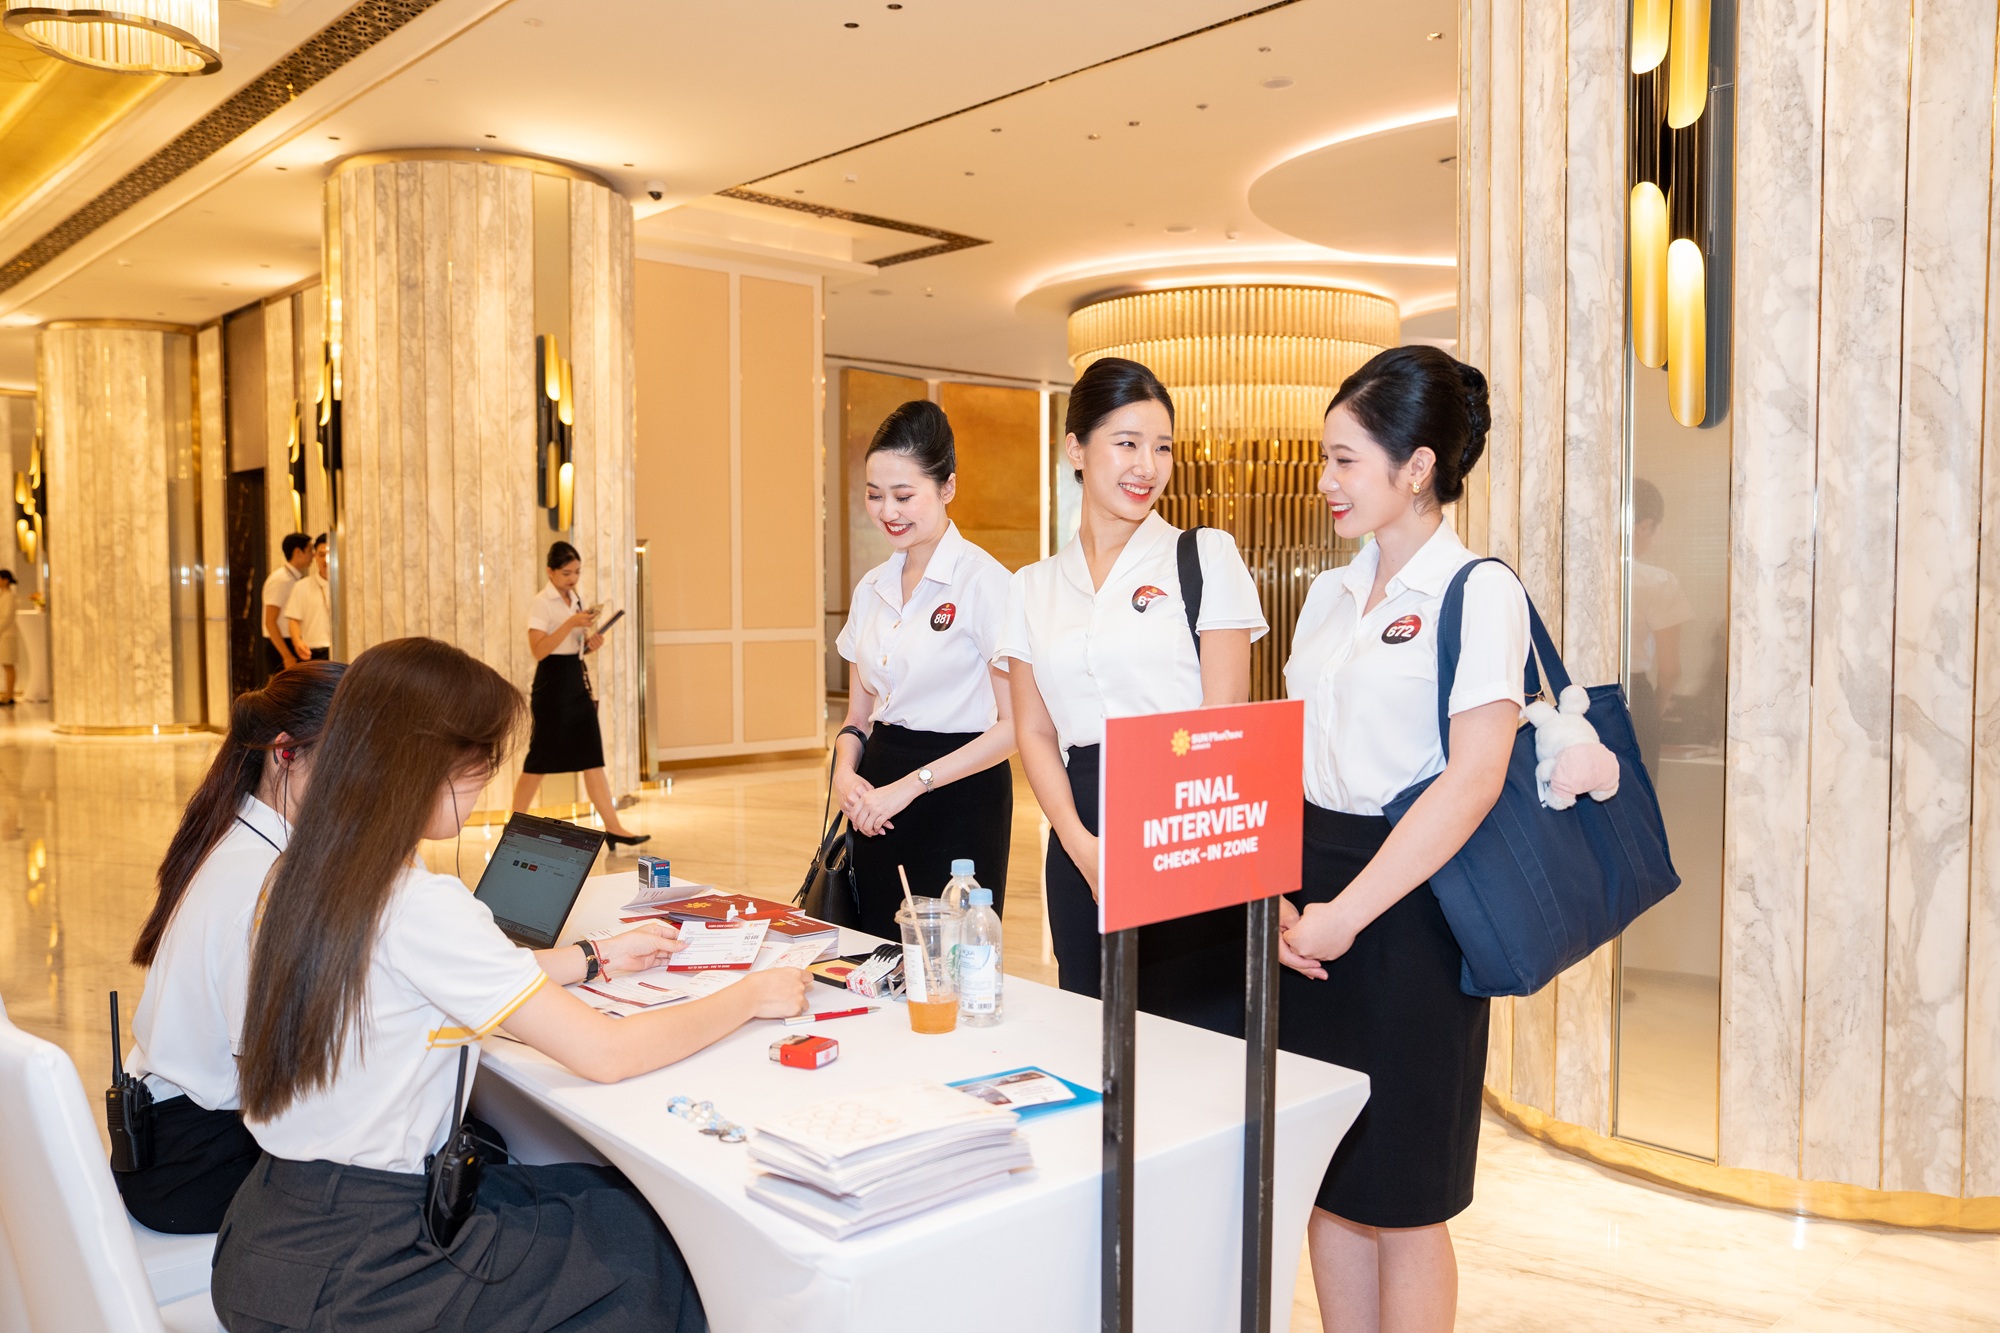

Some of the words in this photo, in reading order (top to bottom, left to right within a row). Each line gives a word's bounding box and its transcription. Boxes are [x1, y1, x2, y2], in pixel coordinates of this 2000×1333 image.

[934, 613, 951, 625] 881
[1386, 624, 1415, 638] 672
[1175, 774, 1240, 810] FINAL
[1143, 800, 1268, 849] INTERVIEW
[1152, 843, 1222, 872] CHECK-IN
[1223, 836, 1259, 858] ZONE
